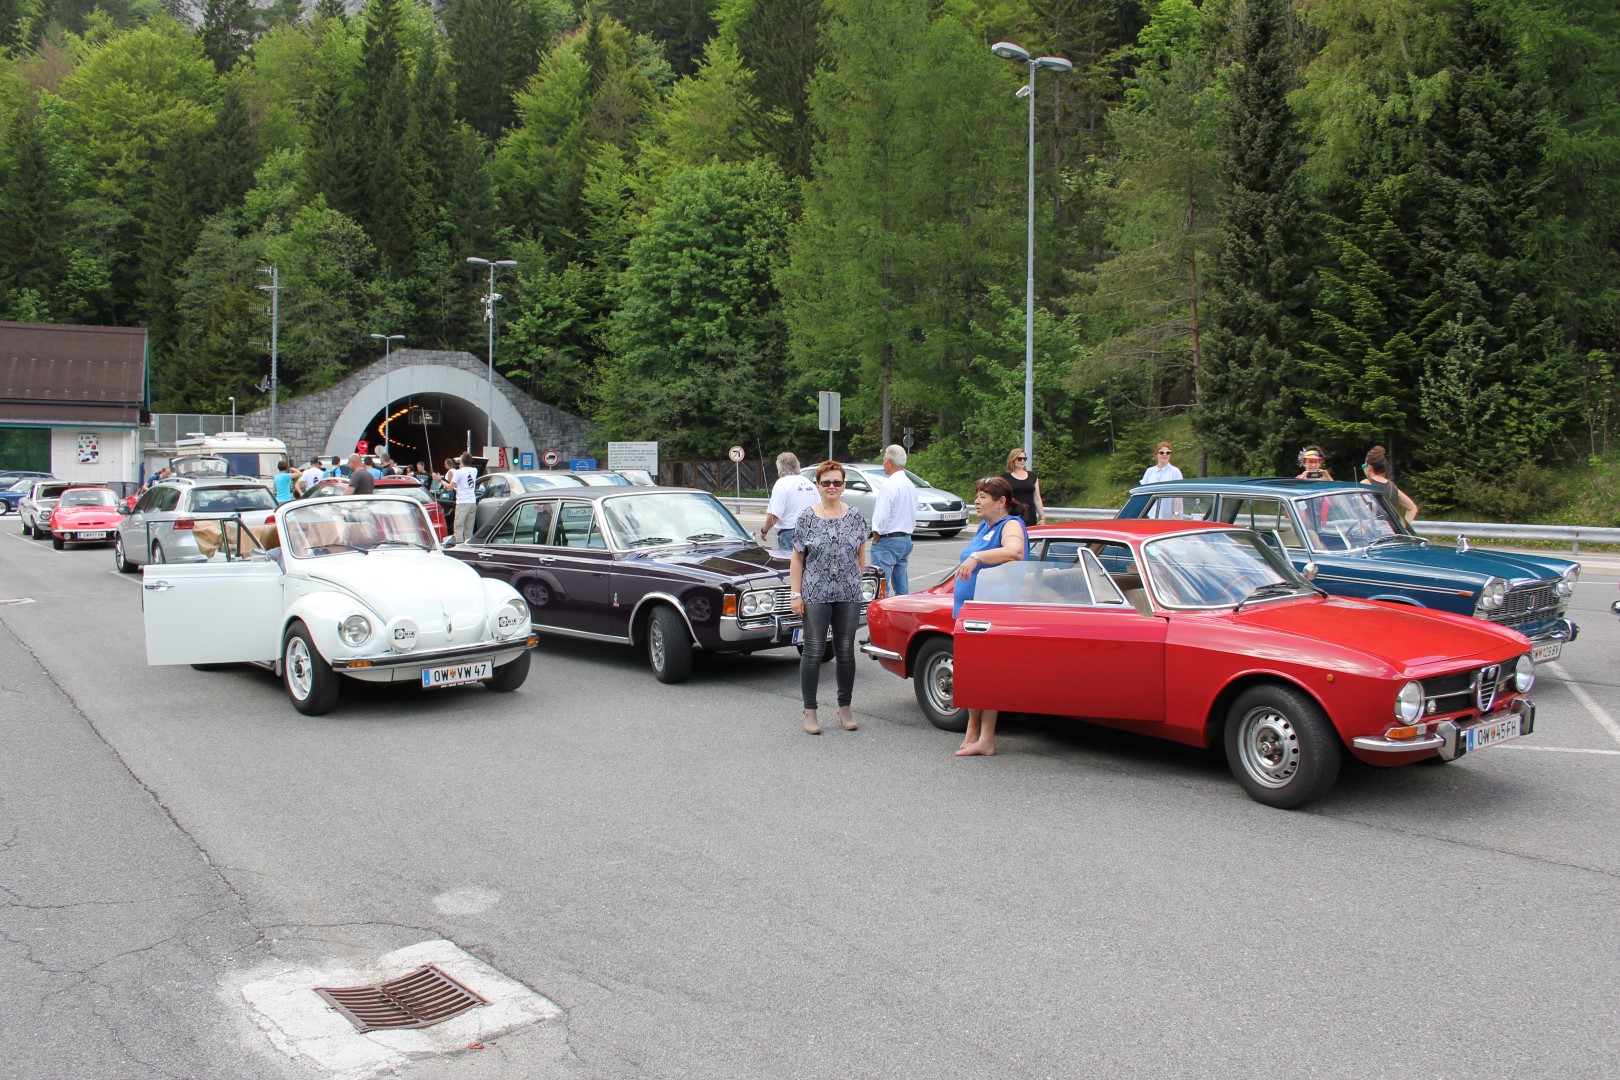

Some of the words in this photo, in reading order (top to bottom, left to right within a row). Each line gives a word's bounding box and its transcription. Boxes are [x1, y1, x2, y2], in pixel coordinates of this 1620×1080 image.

[434, 668, 449, 682] OW
[457, 666, 472, 678] VW
[474, 664, 486, 676] 47
[1478, 728, 1491, 746] OW
